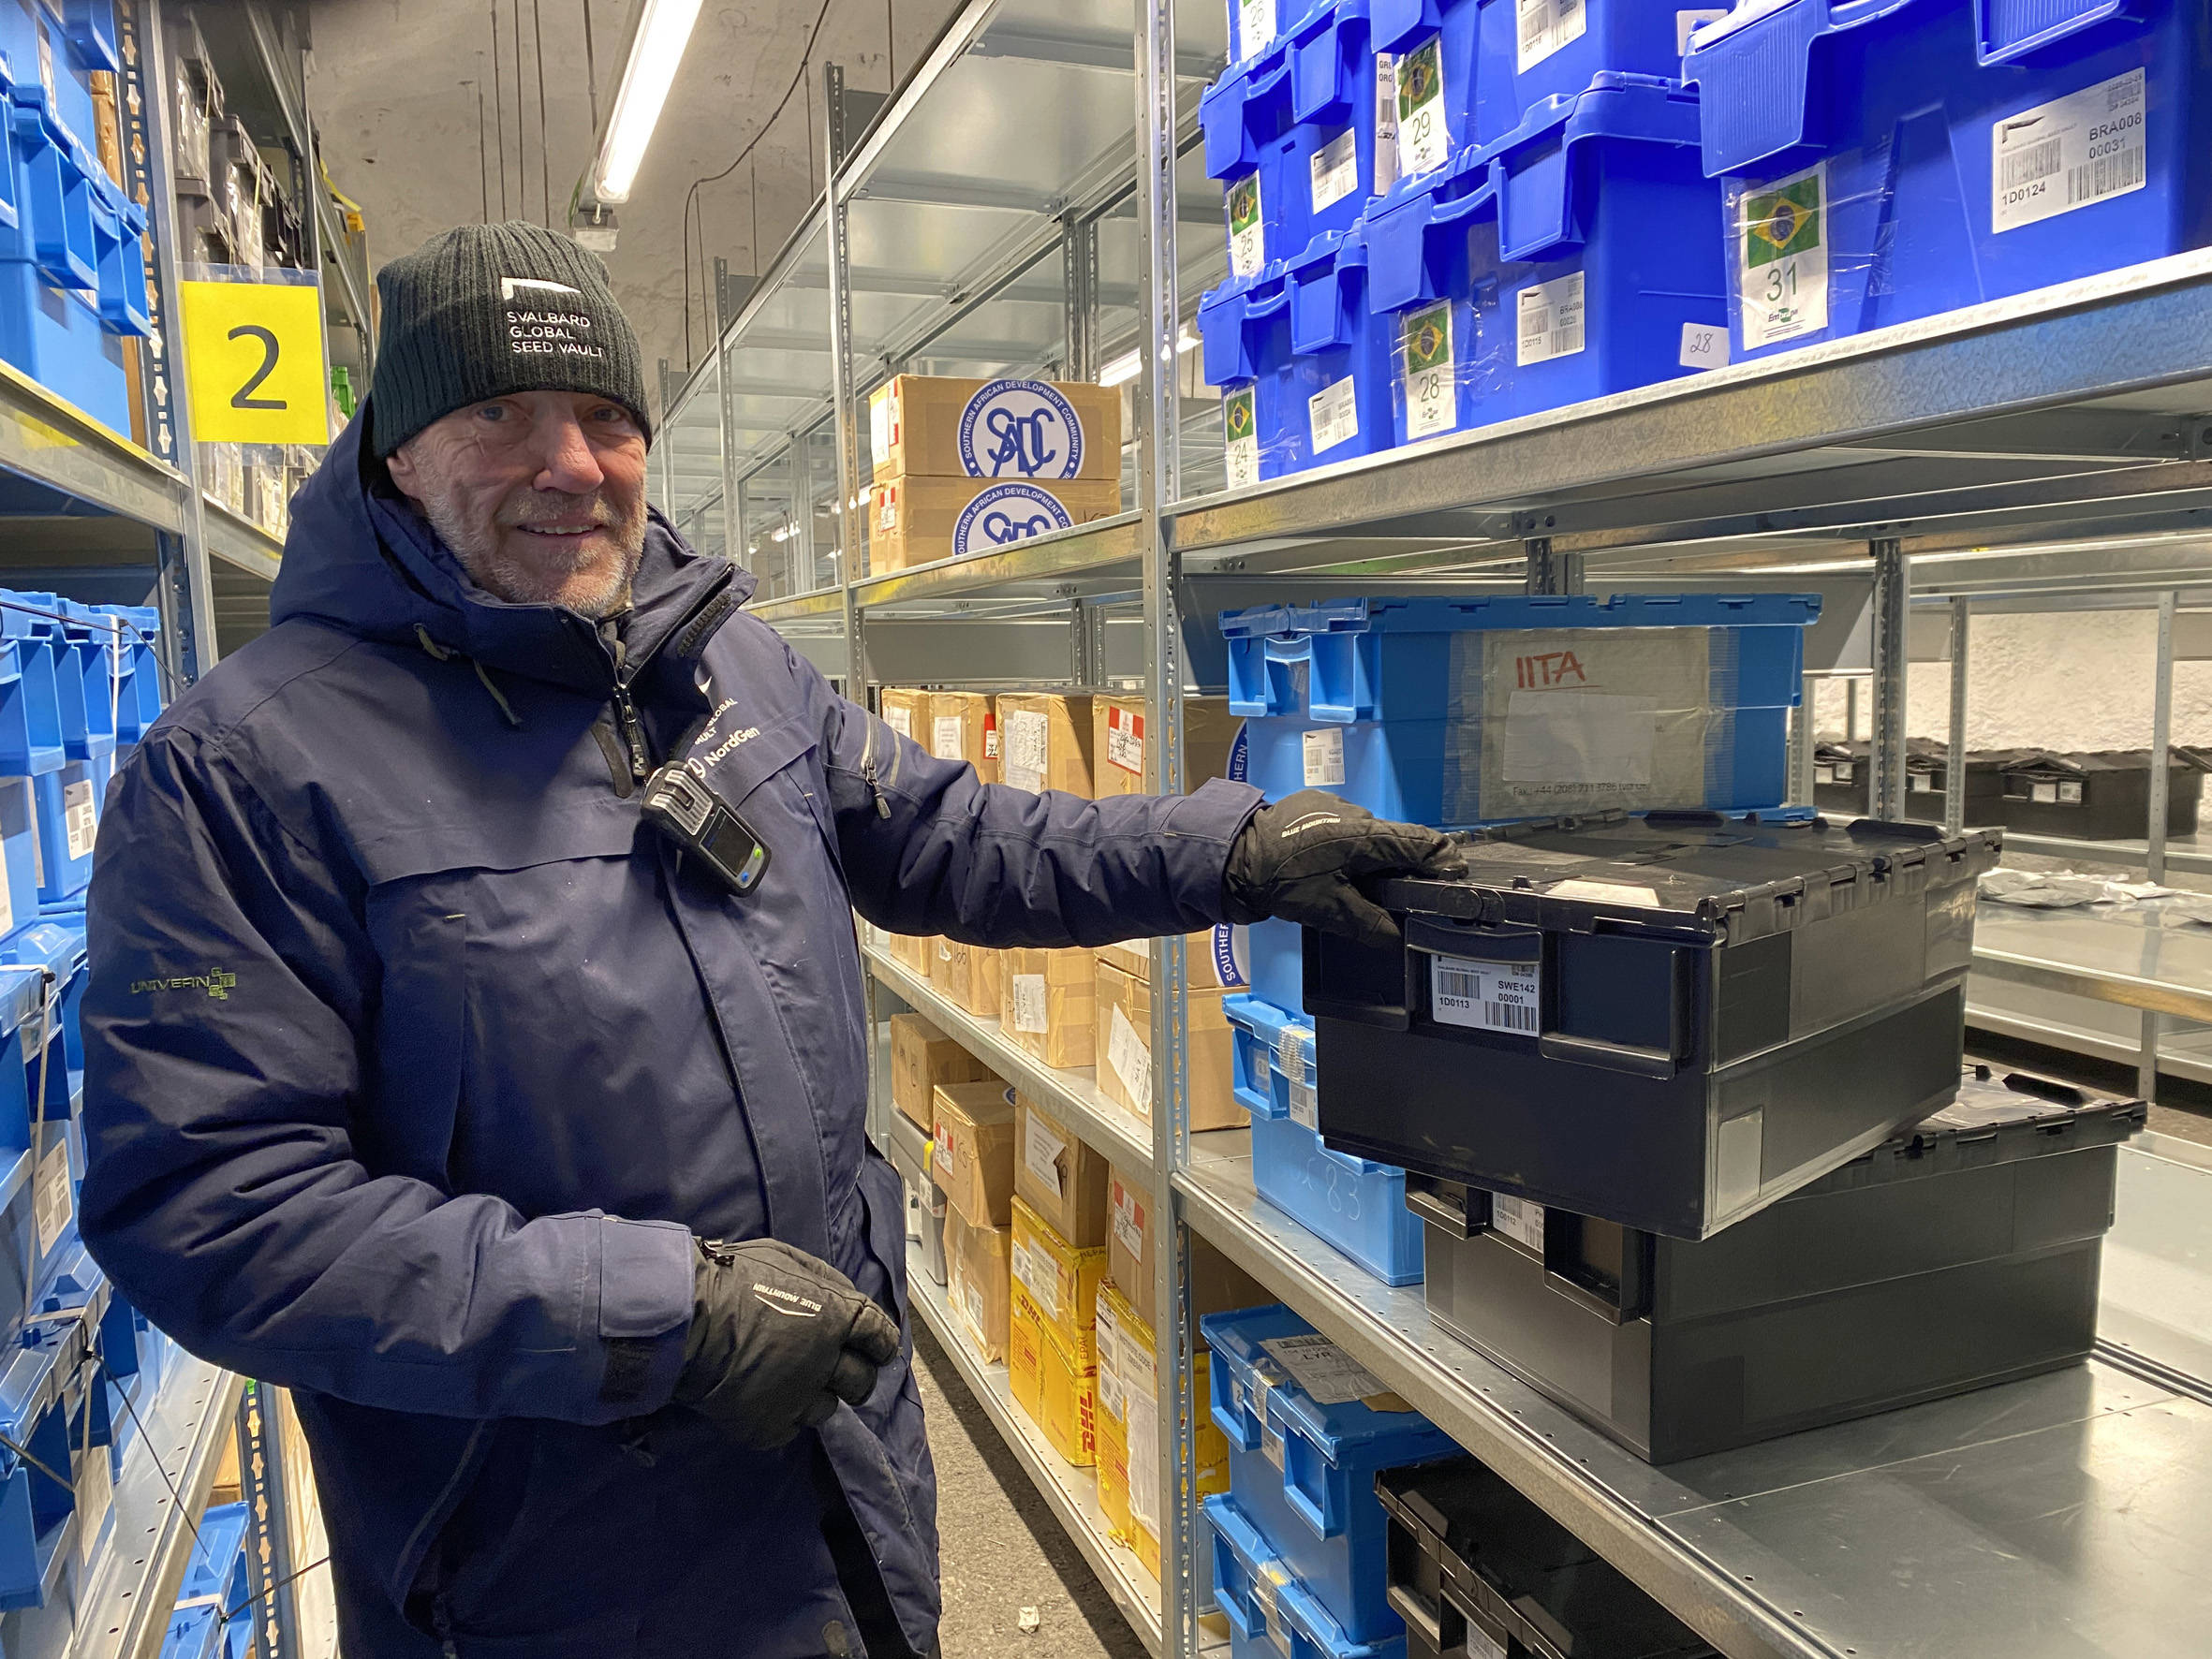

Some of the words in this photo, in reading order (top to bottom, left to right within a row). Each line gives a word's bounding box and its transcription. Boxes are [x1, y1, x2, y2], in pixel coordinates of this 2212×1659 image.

[1412, 110, 1432, 146] 29
[2088, 111, 2143, 141] BRA008
[2088, 136, 2127, 159] 00031
[2001, 181, 2046, 206] 1D0124
[1240, 230, 1255, 257] 25
[1766, 261, 1798, 301] 31
[507, 311, 591, 328] SVALBARD
[509, 326, 577, 339] GLOBAL
[1689, 332, 1713, 354] 28
[511, 341, 553, 353] SEED
[558, 343, 605, 358] VAULT
[227, 324, 288, 411] 2
[1419, 373, 1440, 404] 28
[963, 409, 976, 459] SOUTHERN
[973, 384, 1004, 412] AFRICAN
[1005, 380, 1064, 407] DEVELOPMENT
[1061, 407, 1079, 460] COMMUNITY
[1233, 441, 1248, 466] 24
[957, 512, 974, 554] OUTHERN
[971, 491, 1003, 516] AFRICAN
[1004, 487, 1061, 516] DEVELOPMENT
[1515, 651, 1586, 689] IITA
[694, 727, 717, 745] AULT
[703, 727, 760, 767] NordGen
[1281, 826, 1301, 838] BLUE
[1218, 922, 1236, 981] SOUTHE
[130, 976, 210, 994] UNIVERN
[1498, 980, 1536, 993] SWE142
[1439, 997, 1470, 1008] 1D0113
[1498, 993, 1524, 1005] 00001
[1079, 1390, 1096, 1454] DHL
